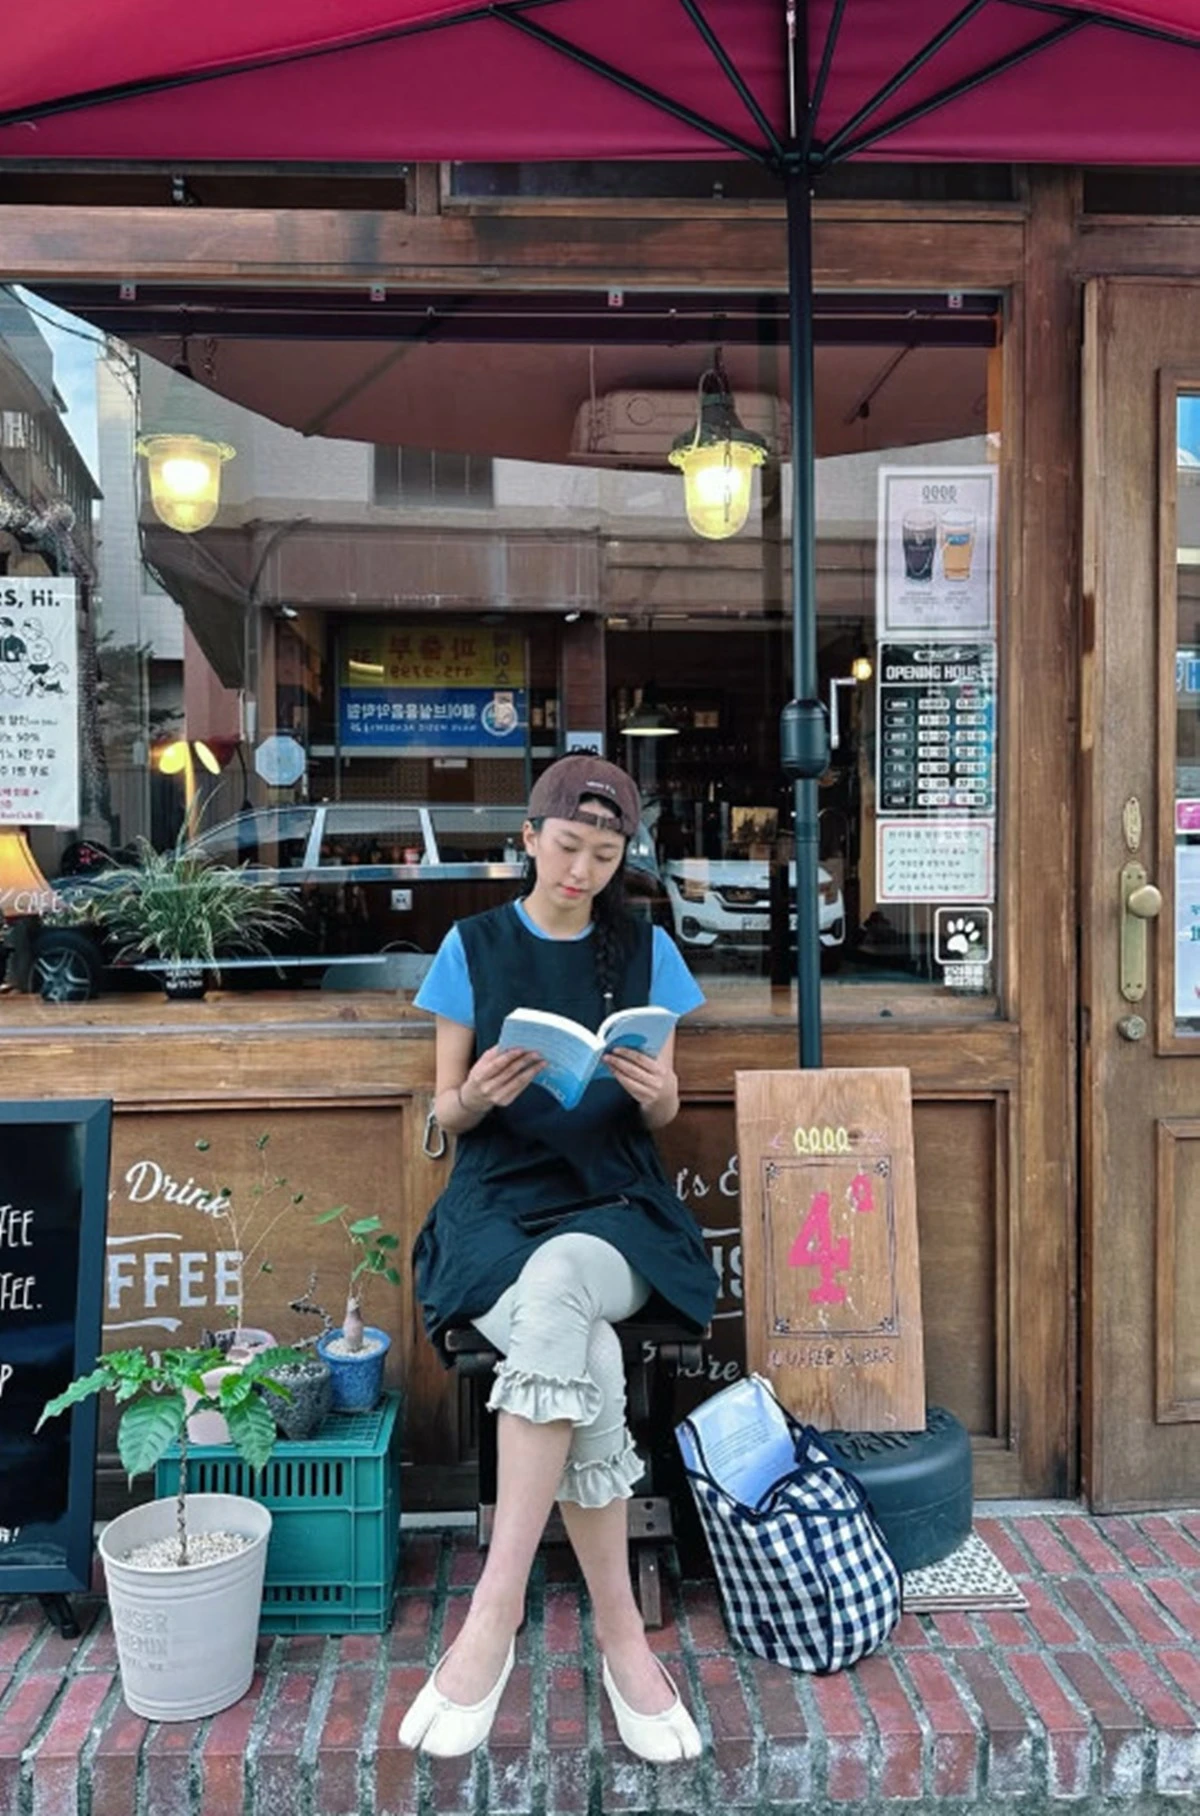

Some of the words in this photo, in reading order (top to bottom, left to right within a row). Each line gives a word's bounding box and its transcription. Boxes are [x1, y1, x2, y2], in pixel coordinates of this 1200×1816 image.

[0, 589, 23, 608] s,
[32, 589, 60, 607] Hi.
[886, 665, 941, 681] OPENING
[126, 1161, 231, 1218] Drink
